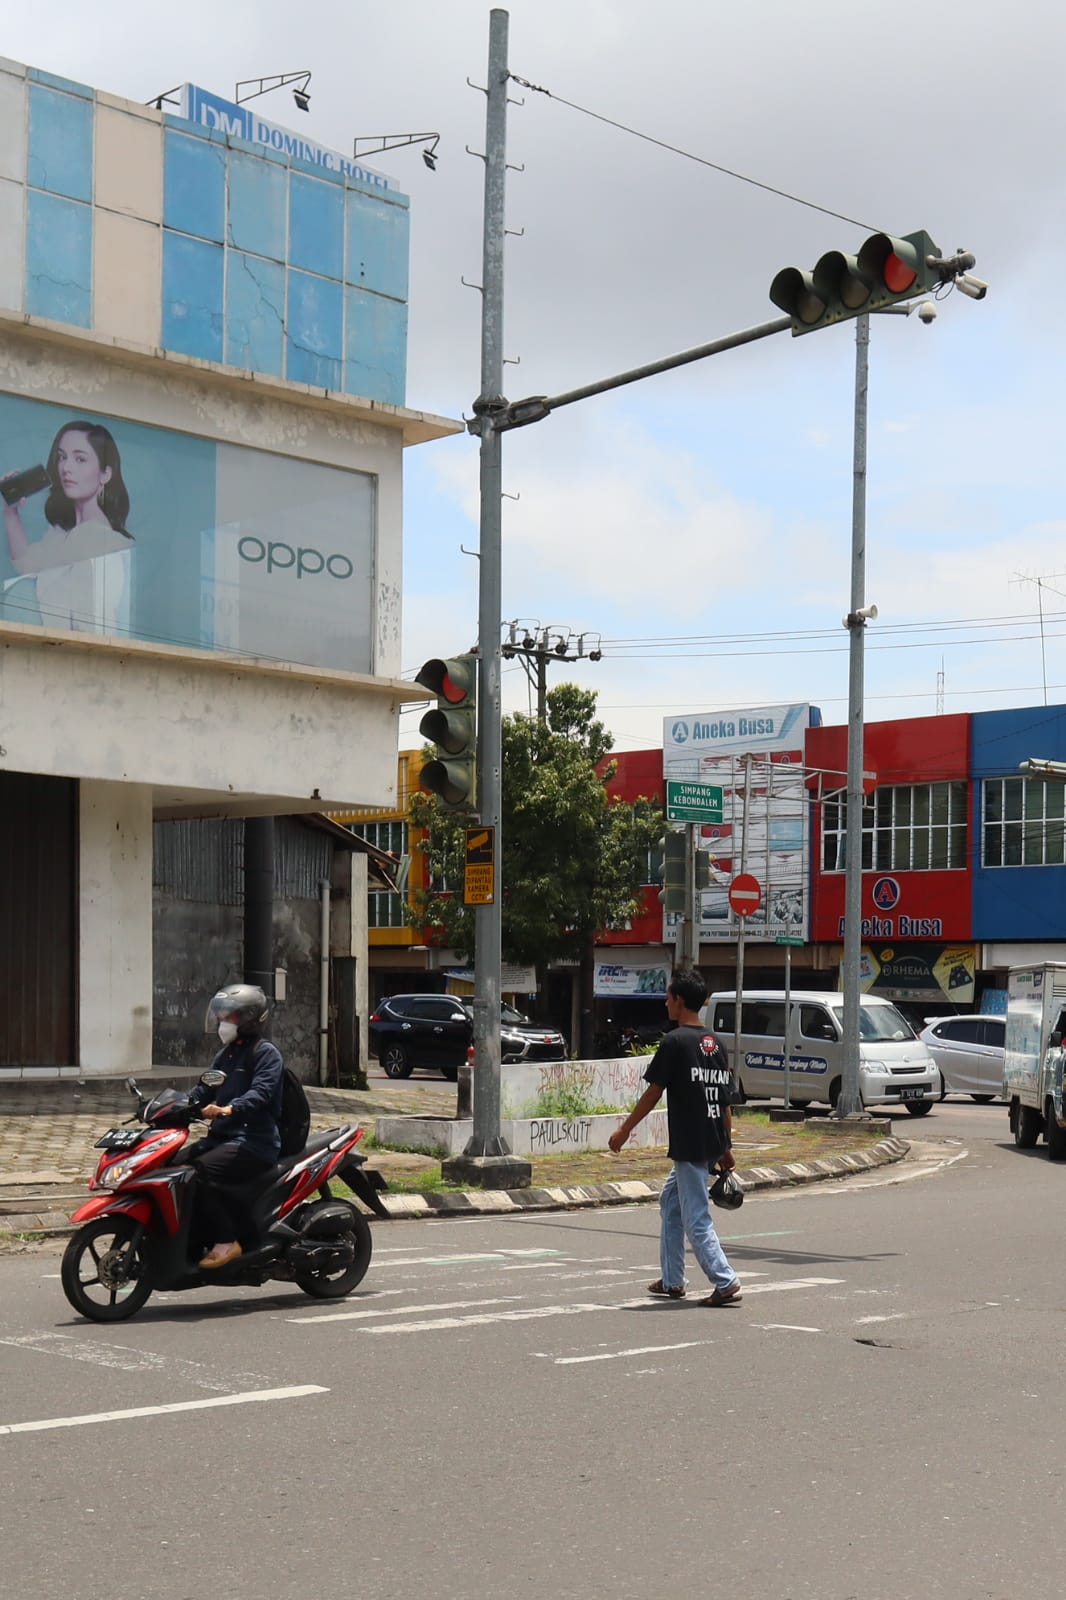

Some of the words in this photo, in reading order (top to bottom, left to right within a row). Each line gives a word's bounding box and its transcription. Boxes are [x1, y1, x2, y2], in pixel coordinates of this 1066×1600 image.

[257, 122, 335, 170] DOMINIC
[238, 536, 353, 579] oppo
[692, 720, 735, 740] Aneka
[739, 718, 774, 737] Busa
[673, 795, 718, 808] KEBONDALEM
[680, 785, 711, 797] SIMPANG
[838, 915, 893, 937] Aeka
[898, 915, 942, 937] Busa
[892, 964, 931, 976] RHEMA
